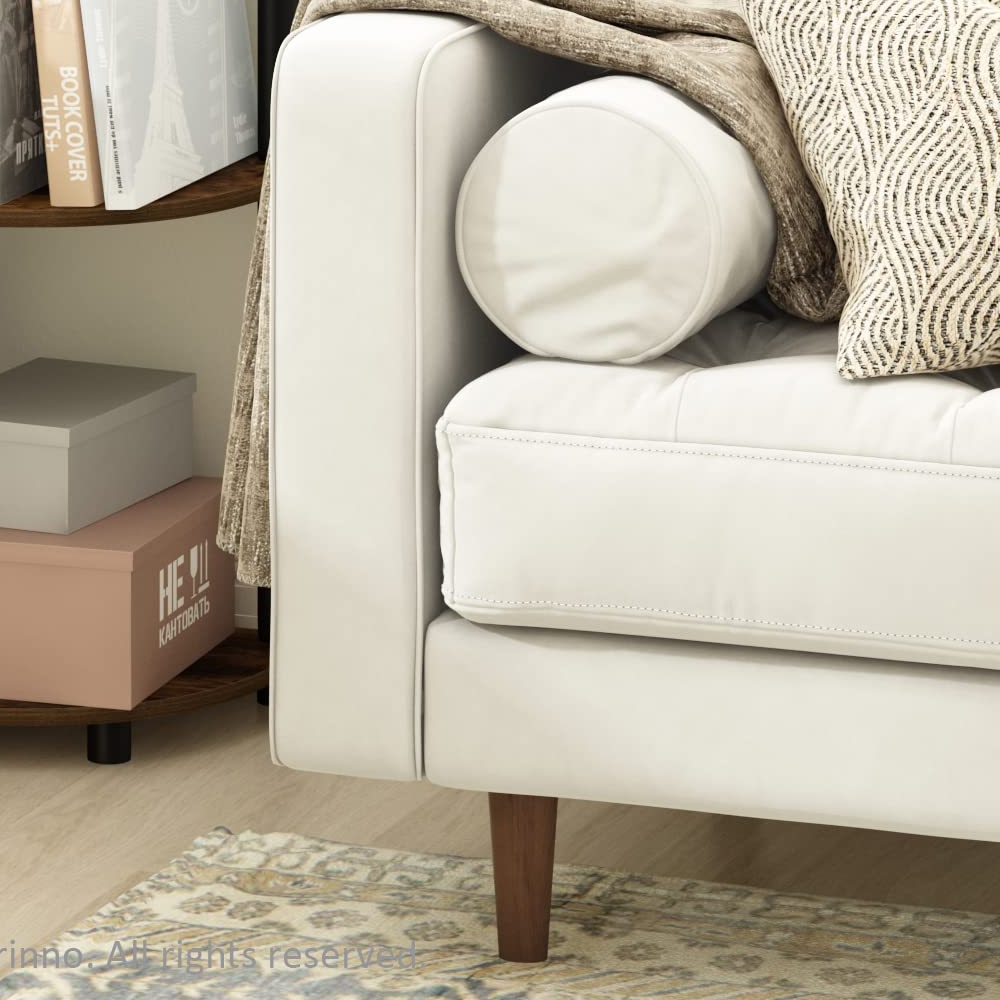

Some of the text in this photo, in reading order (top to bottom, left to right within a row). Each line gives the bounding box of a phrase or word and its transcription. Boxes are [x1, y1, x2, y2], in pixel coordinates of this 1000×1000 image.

[41, 95, 62, 152] TUTS+
[59, 66, 88, 182] BOOK COVER
[160, 554, 185, 622] НЕ
[159, 596, 210, 648] КАНТОВАТЬ
